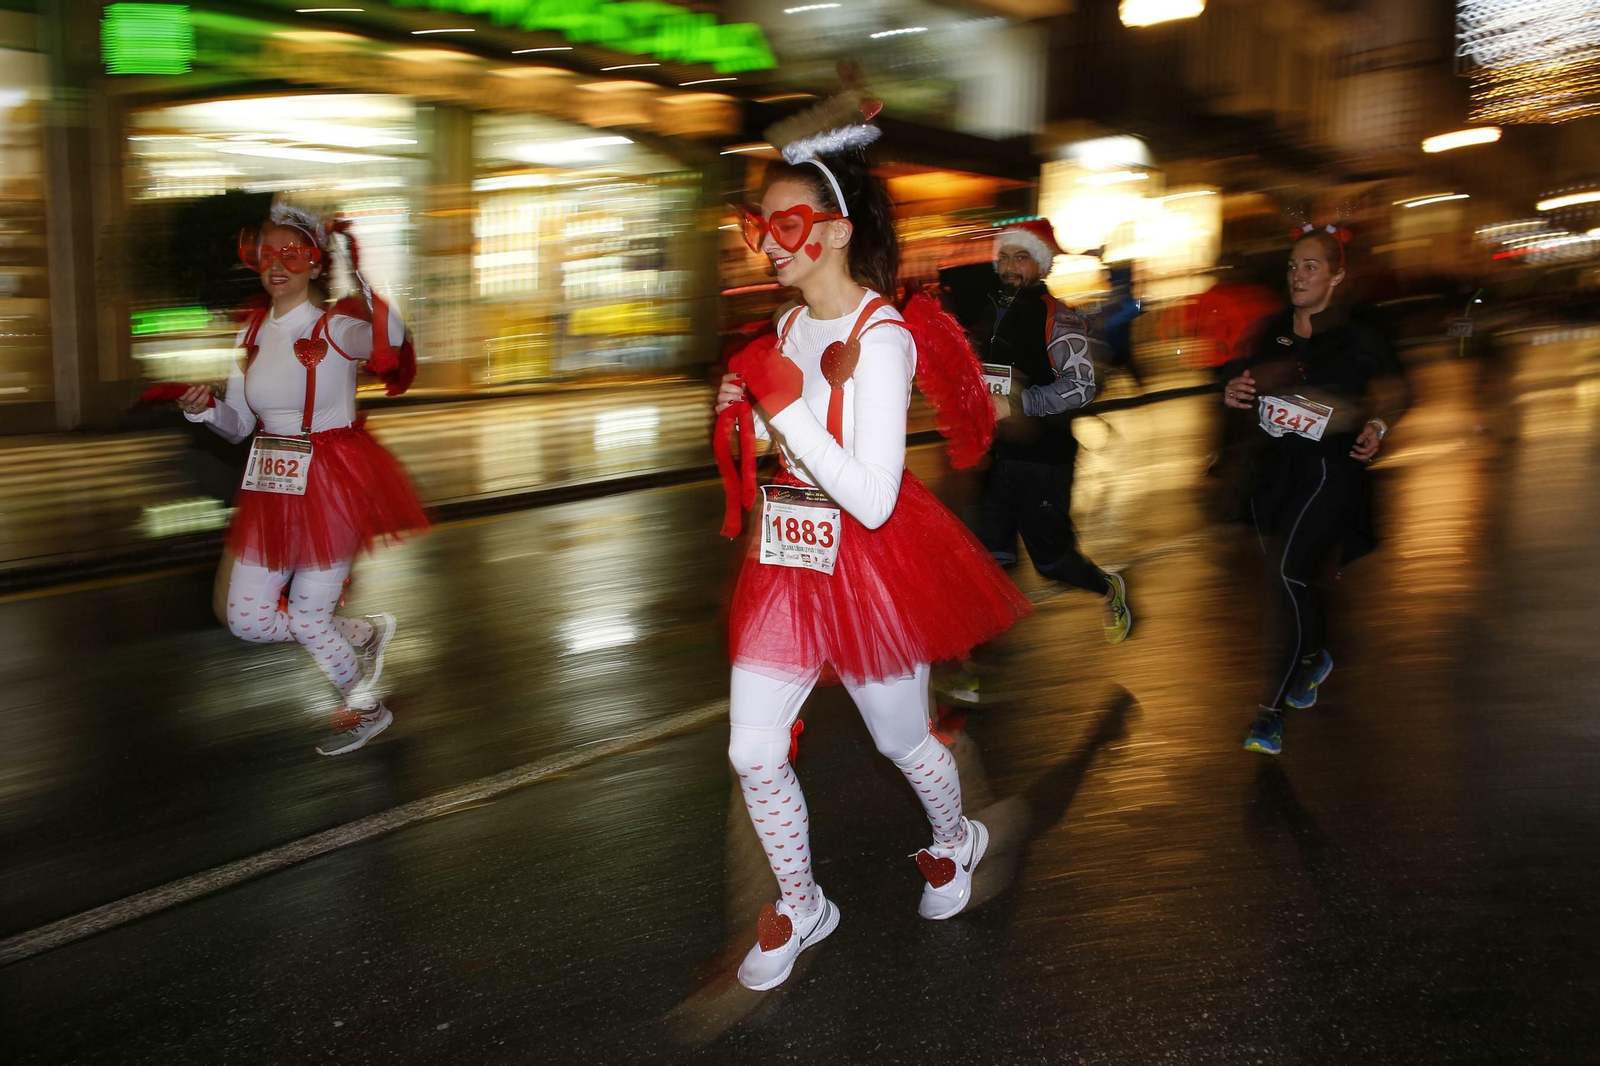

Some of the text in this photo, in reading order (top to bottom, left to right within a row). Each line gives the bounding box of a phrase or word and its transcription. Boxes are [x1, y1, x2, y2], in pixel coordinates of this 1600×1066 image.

[1267, 404, 1317, 432] 1247
[258, 457, 299, 478] 1862
[772, 515, 834, 549] 1883
